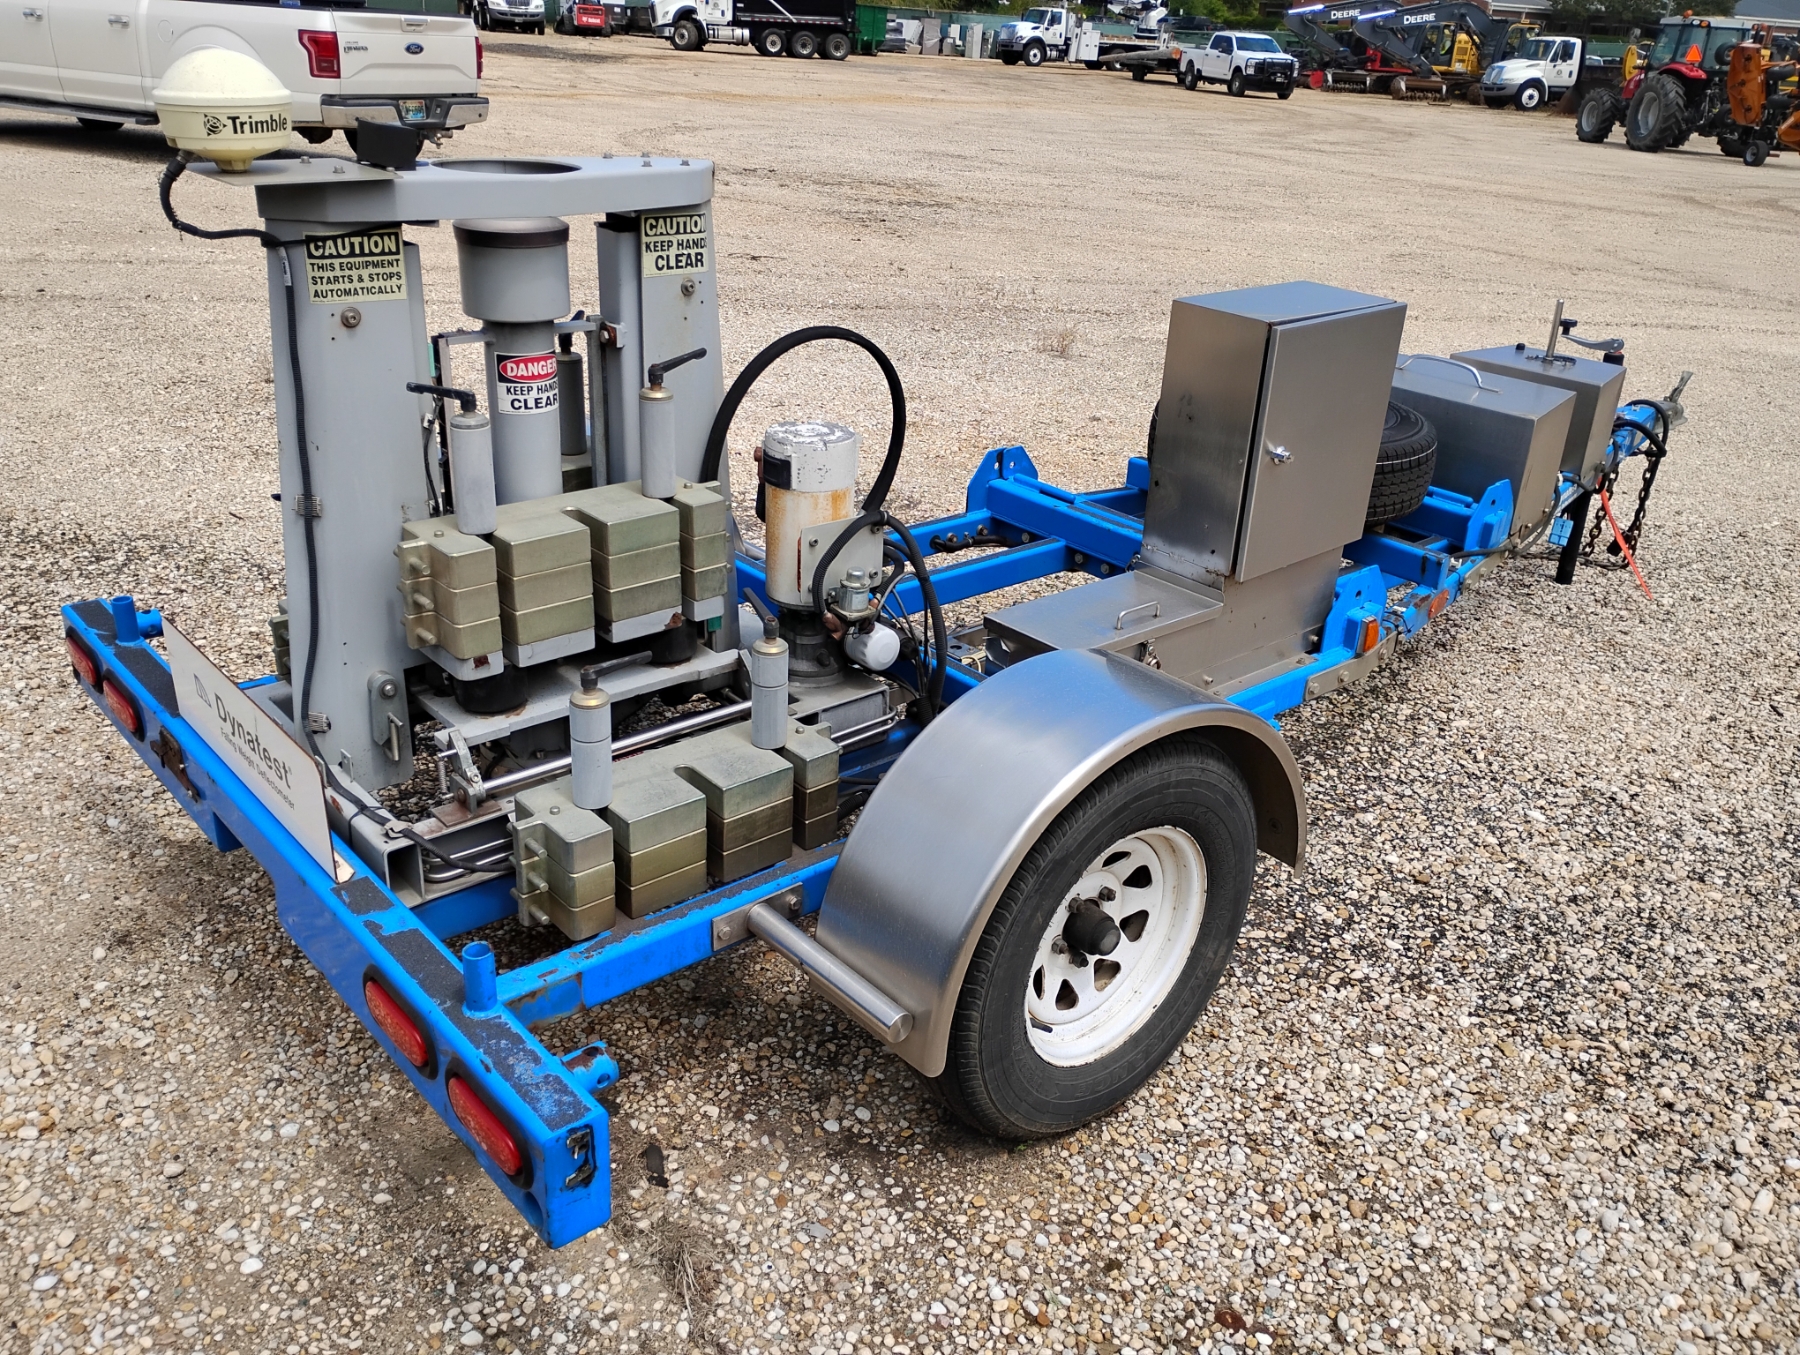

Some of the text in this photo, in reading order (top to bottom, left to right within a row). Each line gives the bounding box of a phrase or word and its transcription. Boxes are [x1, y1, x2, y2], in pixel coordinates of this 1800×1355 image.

[1331, 9, 1361, 19] DEERE
[1404, 13, 1436, 24] DEERE
[227, 113, 287, 135] Trimble
[309, 235, 397, 257] CAUTION
[645, 240, 674, 253] KEEP
[310, 258, 400, 273] THIS EQUIPMENT
[655, 252, 704, 271] CLEAR
[311, 271, 402, 286] STARTS & STOPS
[313, 283, 402, 299] AUTOMATICALLY
[506, 357, 557, 377] DANGER
[506, 385, 533, 396] KEEP
[510, 393, 558, 411] CLEAR
[214, 692, 291, 790] Dynatest
[237, 743, 256, 771] Weight
